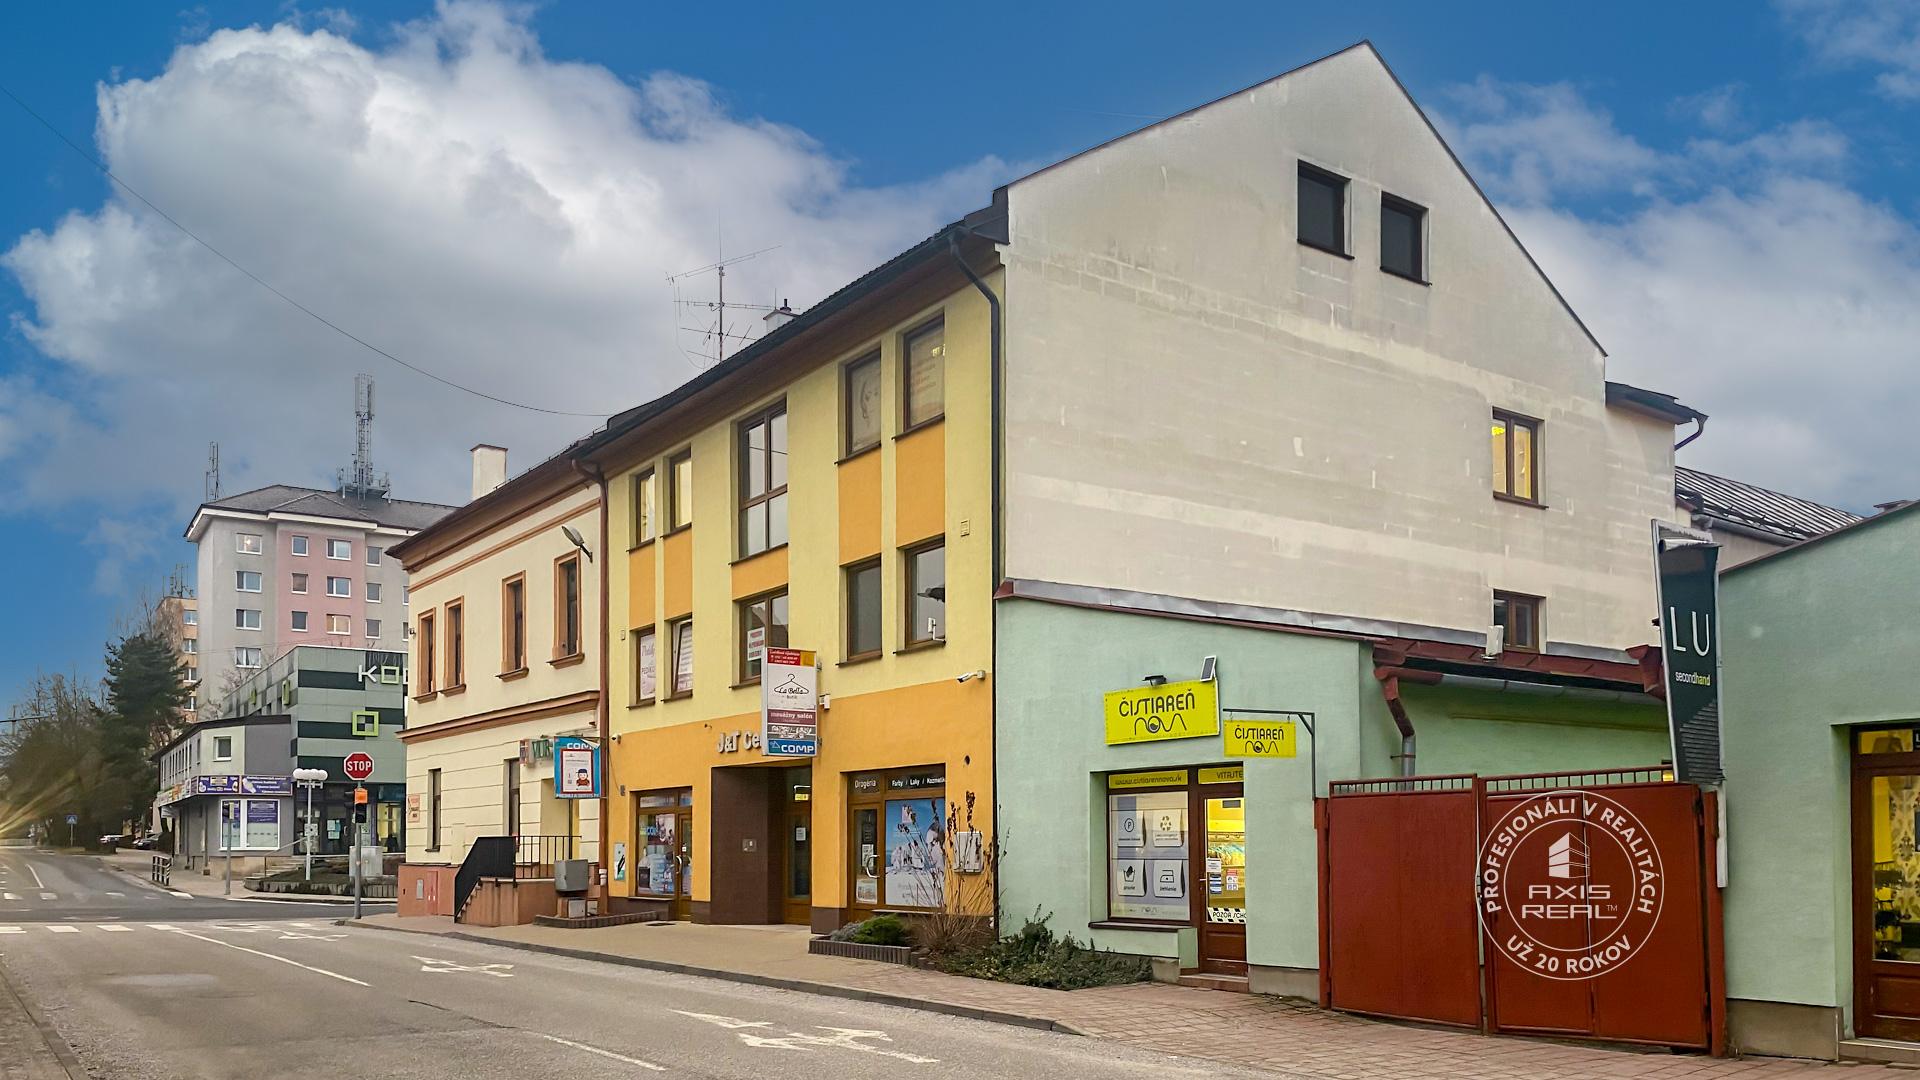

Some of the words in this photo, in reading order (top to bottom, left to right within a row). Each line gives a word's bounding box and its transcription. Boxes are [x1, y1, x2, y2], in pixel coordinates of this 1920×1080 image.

[1670, 606, 1709, 656] LU
[1675, 671, 1710, 686] secondhand
[1119, 689, 1195, 717] ČISTIAREŇ
[1234, 724, 1284, 740] ČISTIAREŇ
[717, 731, 741, 753] J&T
[743, 730, 762, 750] Ce
[781, 745, 815, 753] COMP
[346, 761, 372, 771] STOP
[1216, 771, 1243, 779] VITAJTE
[1213, 911, 1231, 919] POZOR
